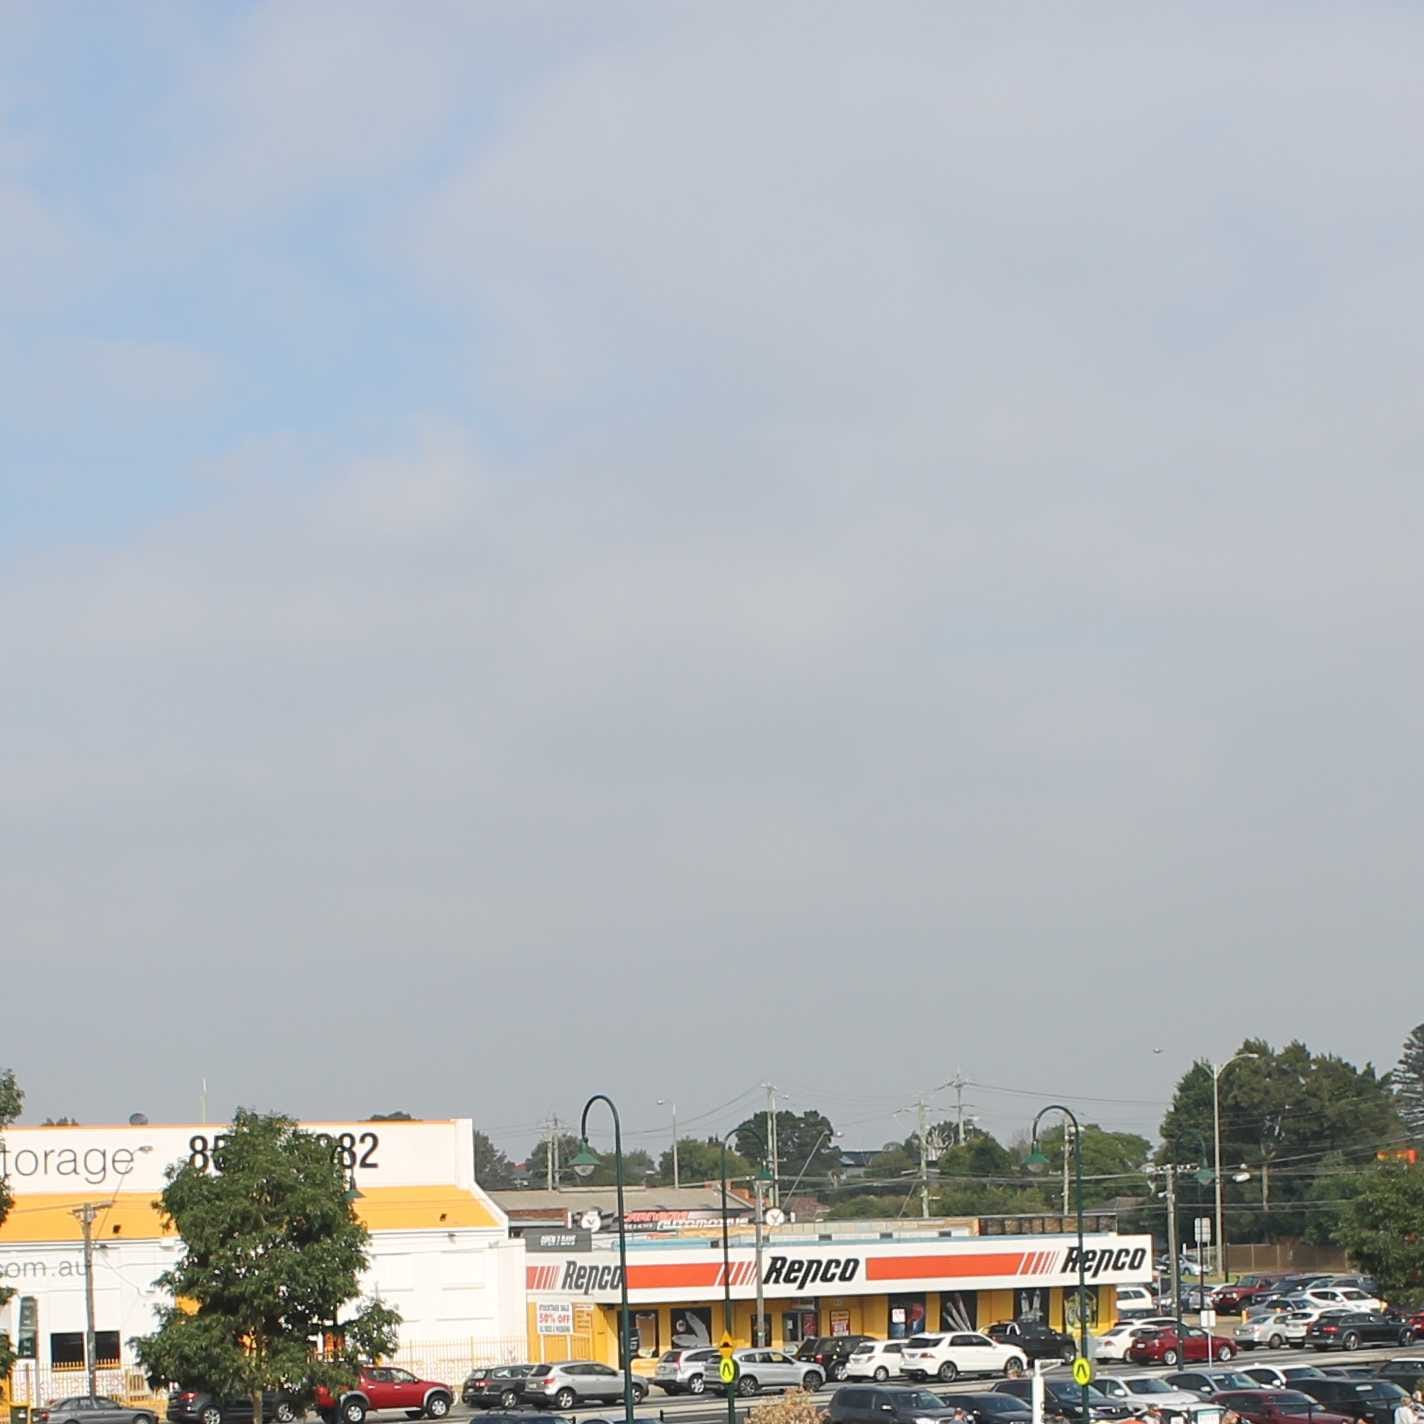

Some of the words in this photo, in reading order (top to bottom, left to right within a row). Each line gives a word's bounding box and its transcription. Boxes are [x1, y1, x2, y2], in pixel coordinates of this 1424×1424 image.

[3, 1143, 134, 1185] torage
[561, 1260, 623, 1295] Repco
[763, 1256, 860, 1290] Repco
[1060, 1246, 1146, 1278] Repco
